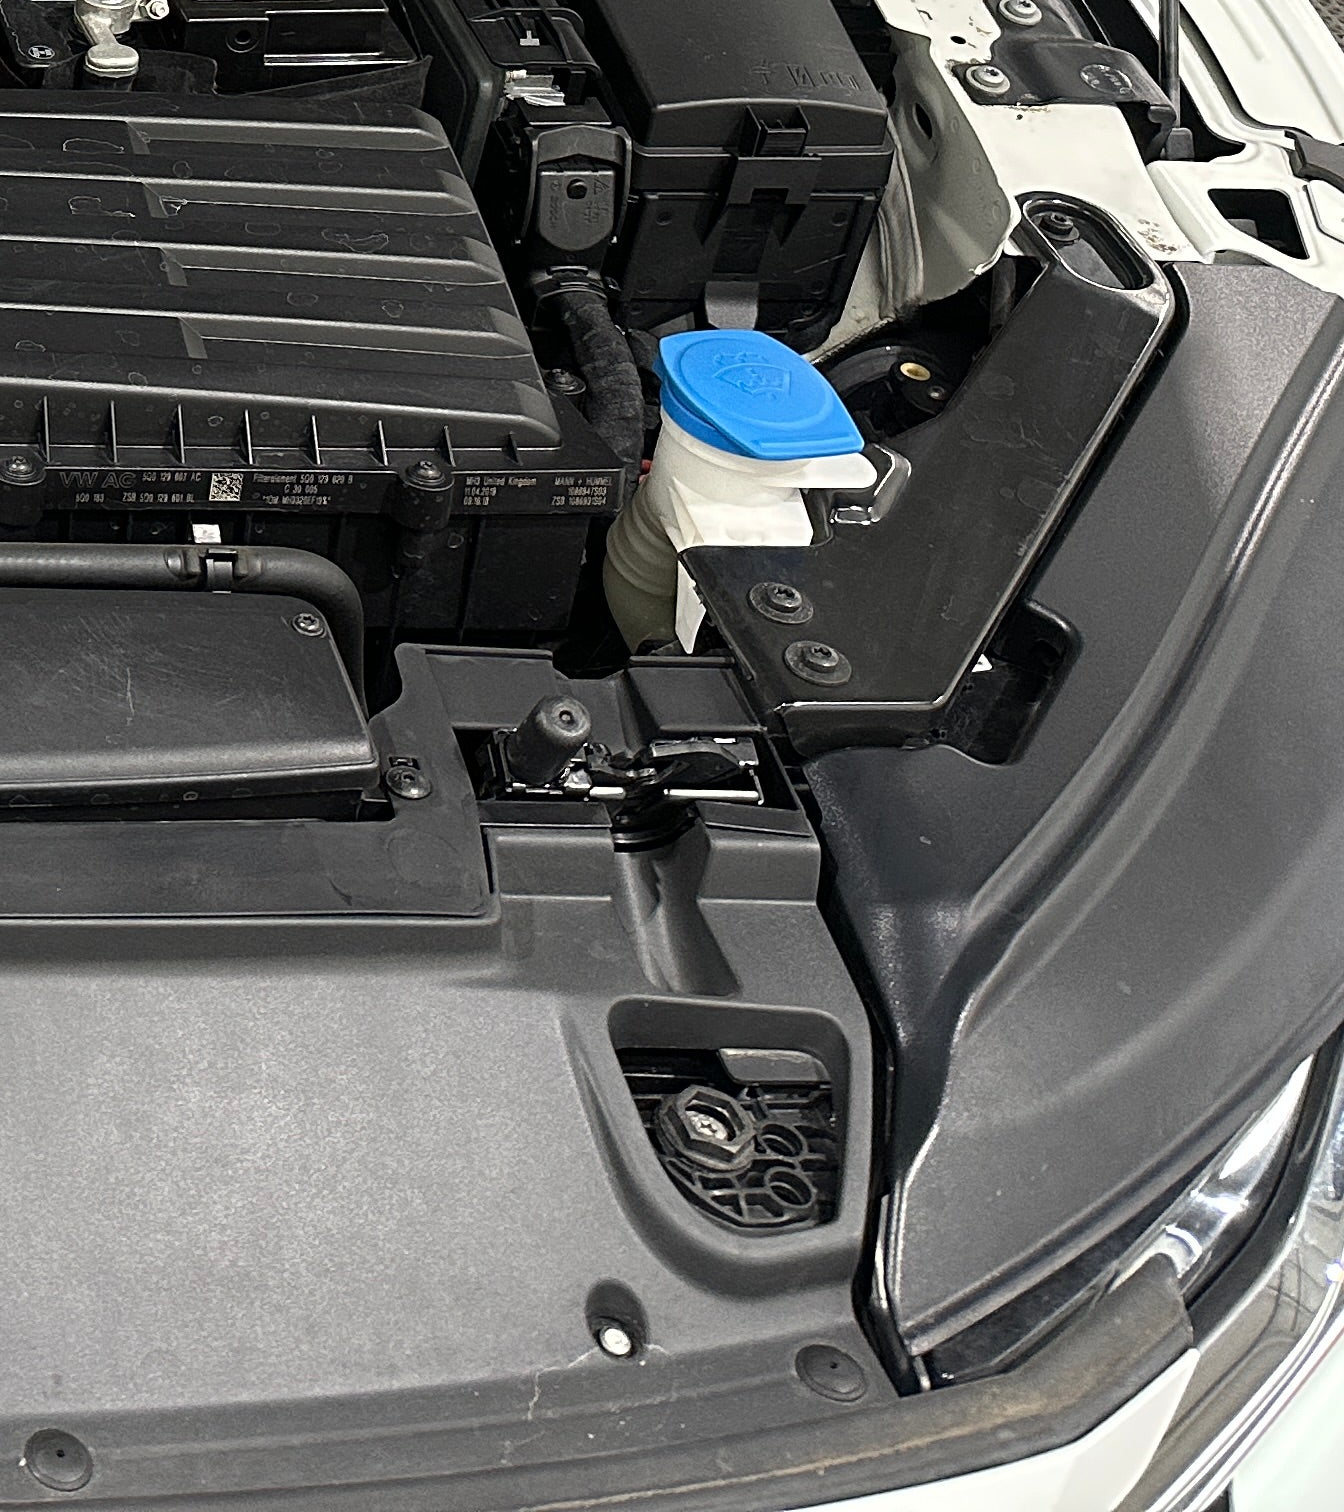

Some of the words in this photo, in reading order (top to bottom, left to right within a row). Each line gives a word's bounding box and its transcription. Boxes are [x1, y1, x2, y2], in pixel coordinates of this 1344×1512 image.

[59, 472, 99, 488] VW
[101, 472, 137, 488] AG
[483, 477, 505, 486] United
[508, 477, 537, 488] Kingdom
